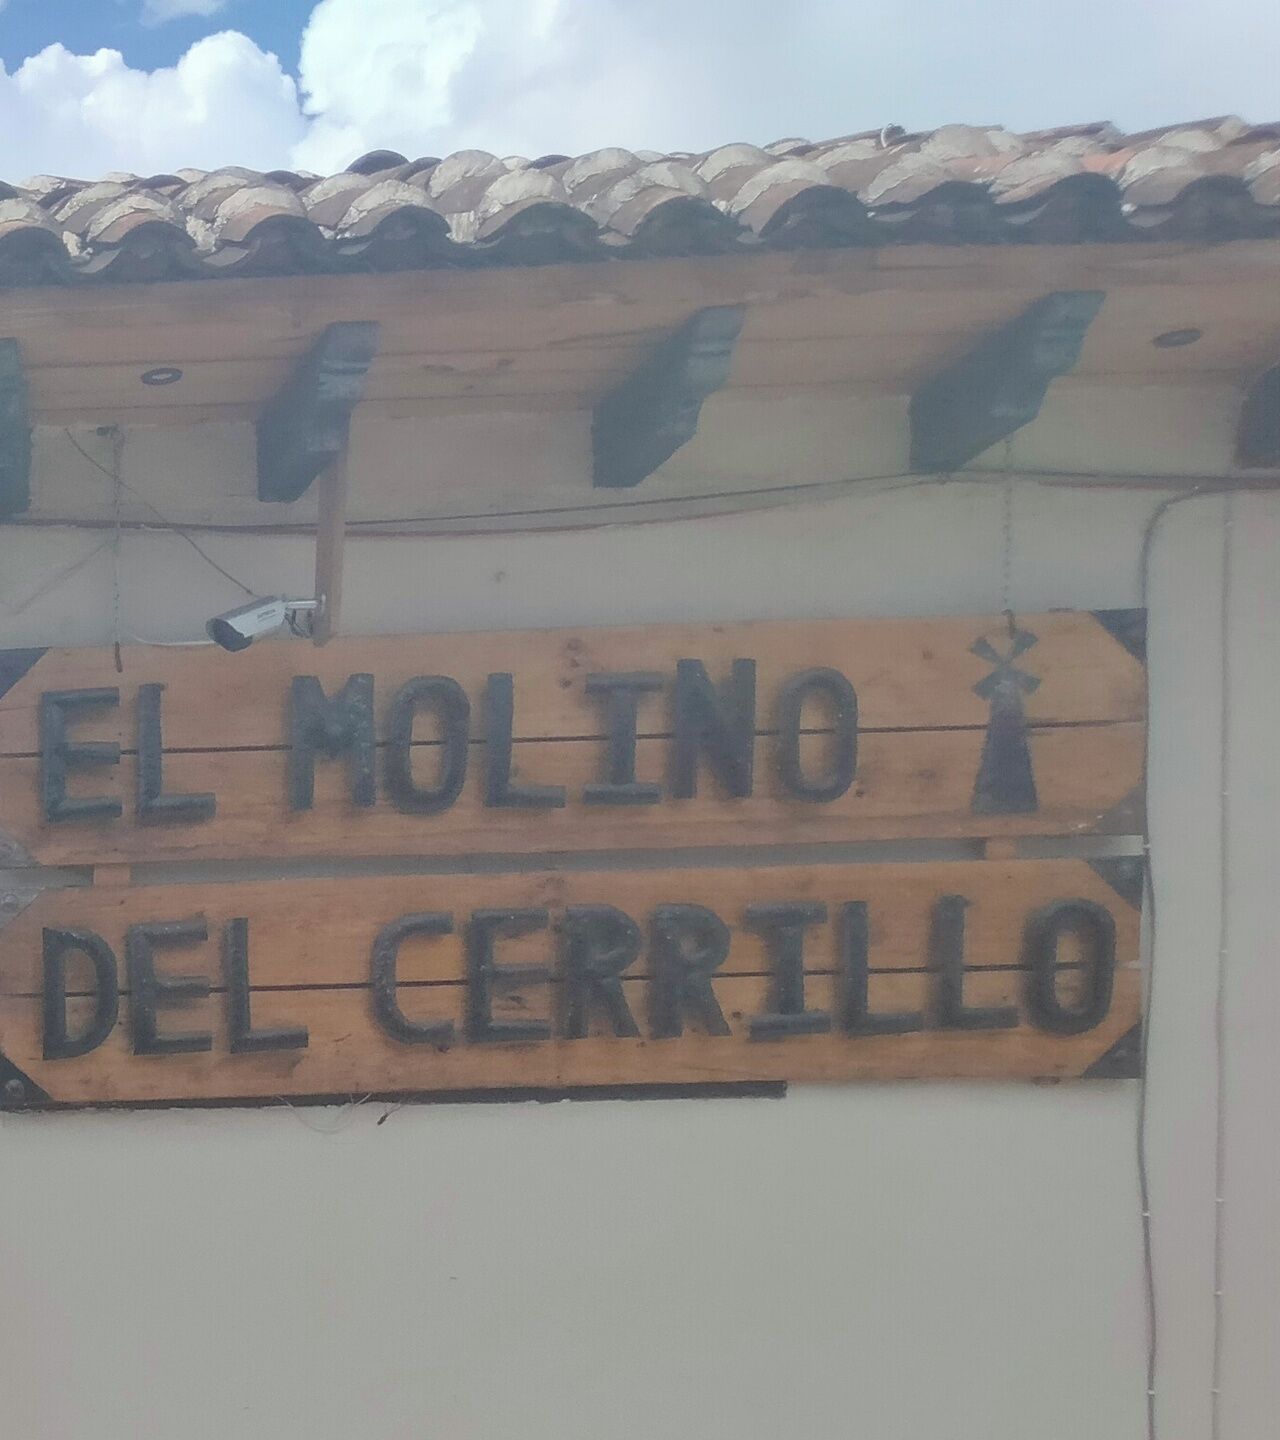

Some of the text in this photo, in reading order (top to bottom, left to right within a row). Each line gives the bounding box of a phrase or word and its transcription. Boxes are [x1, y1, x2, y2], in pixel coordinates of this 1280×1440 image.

[40, 657, 859, 822] EL MOLINO
[41, 895, 1117, 1060] DEL CERRILLO
